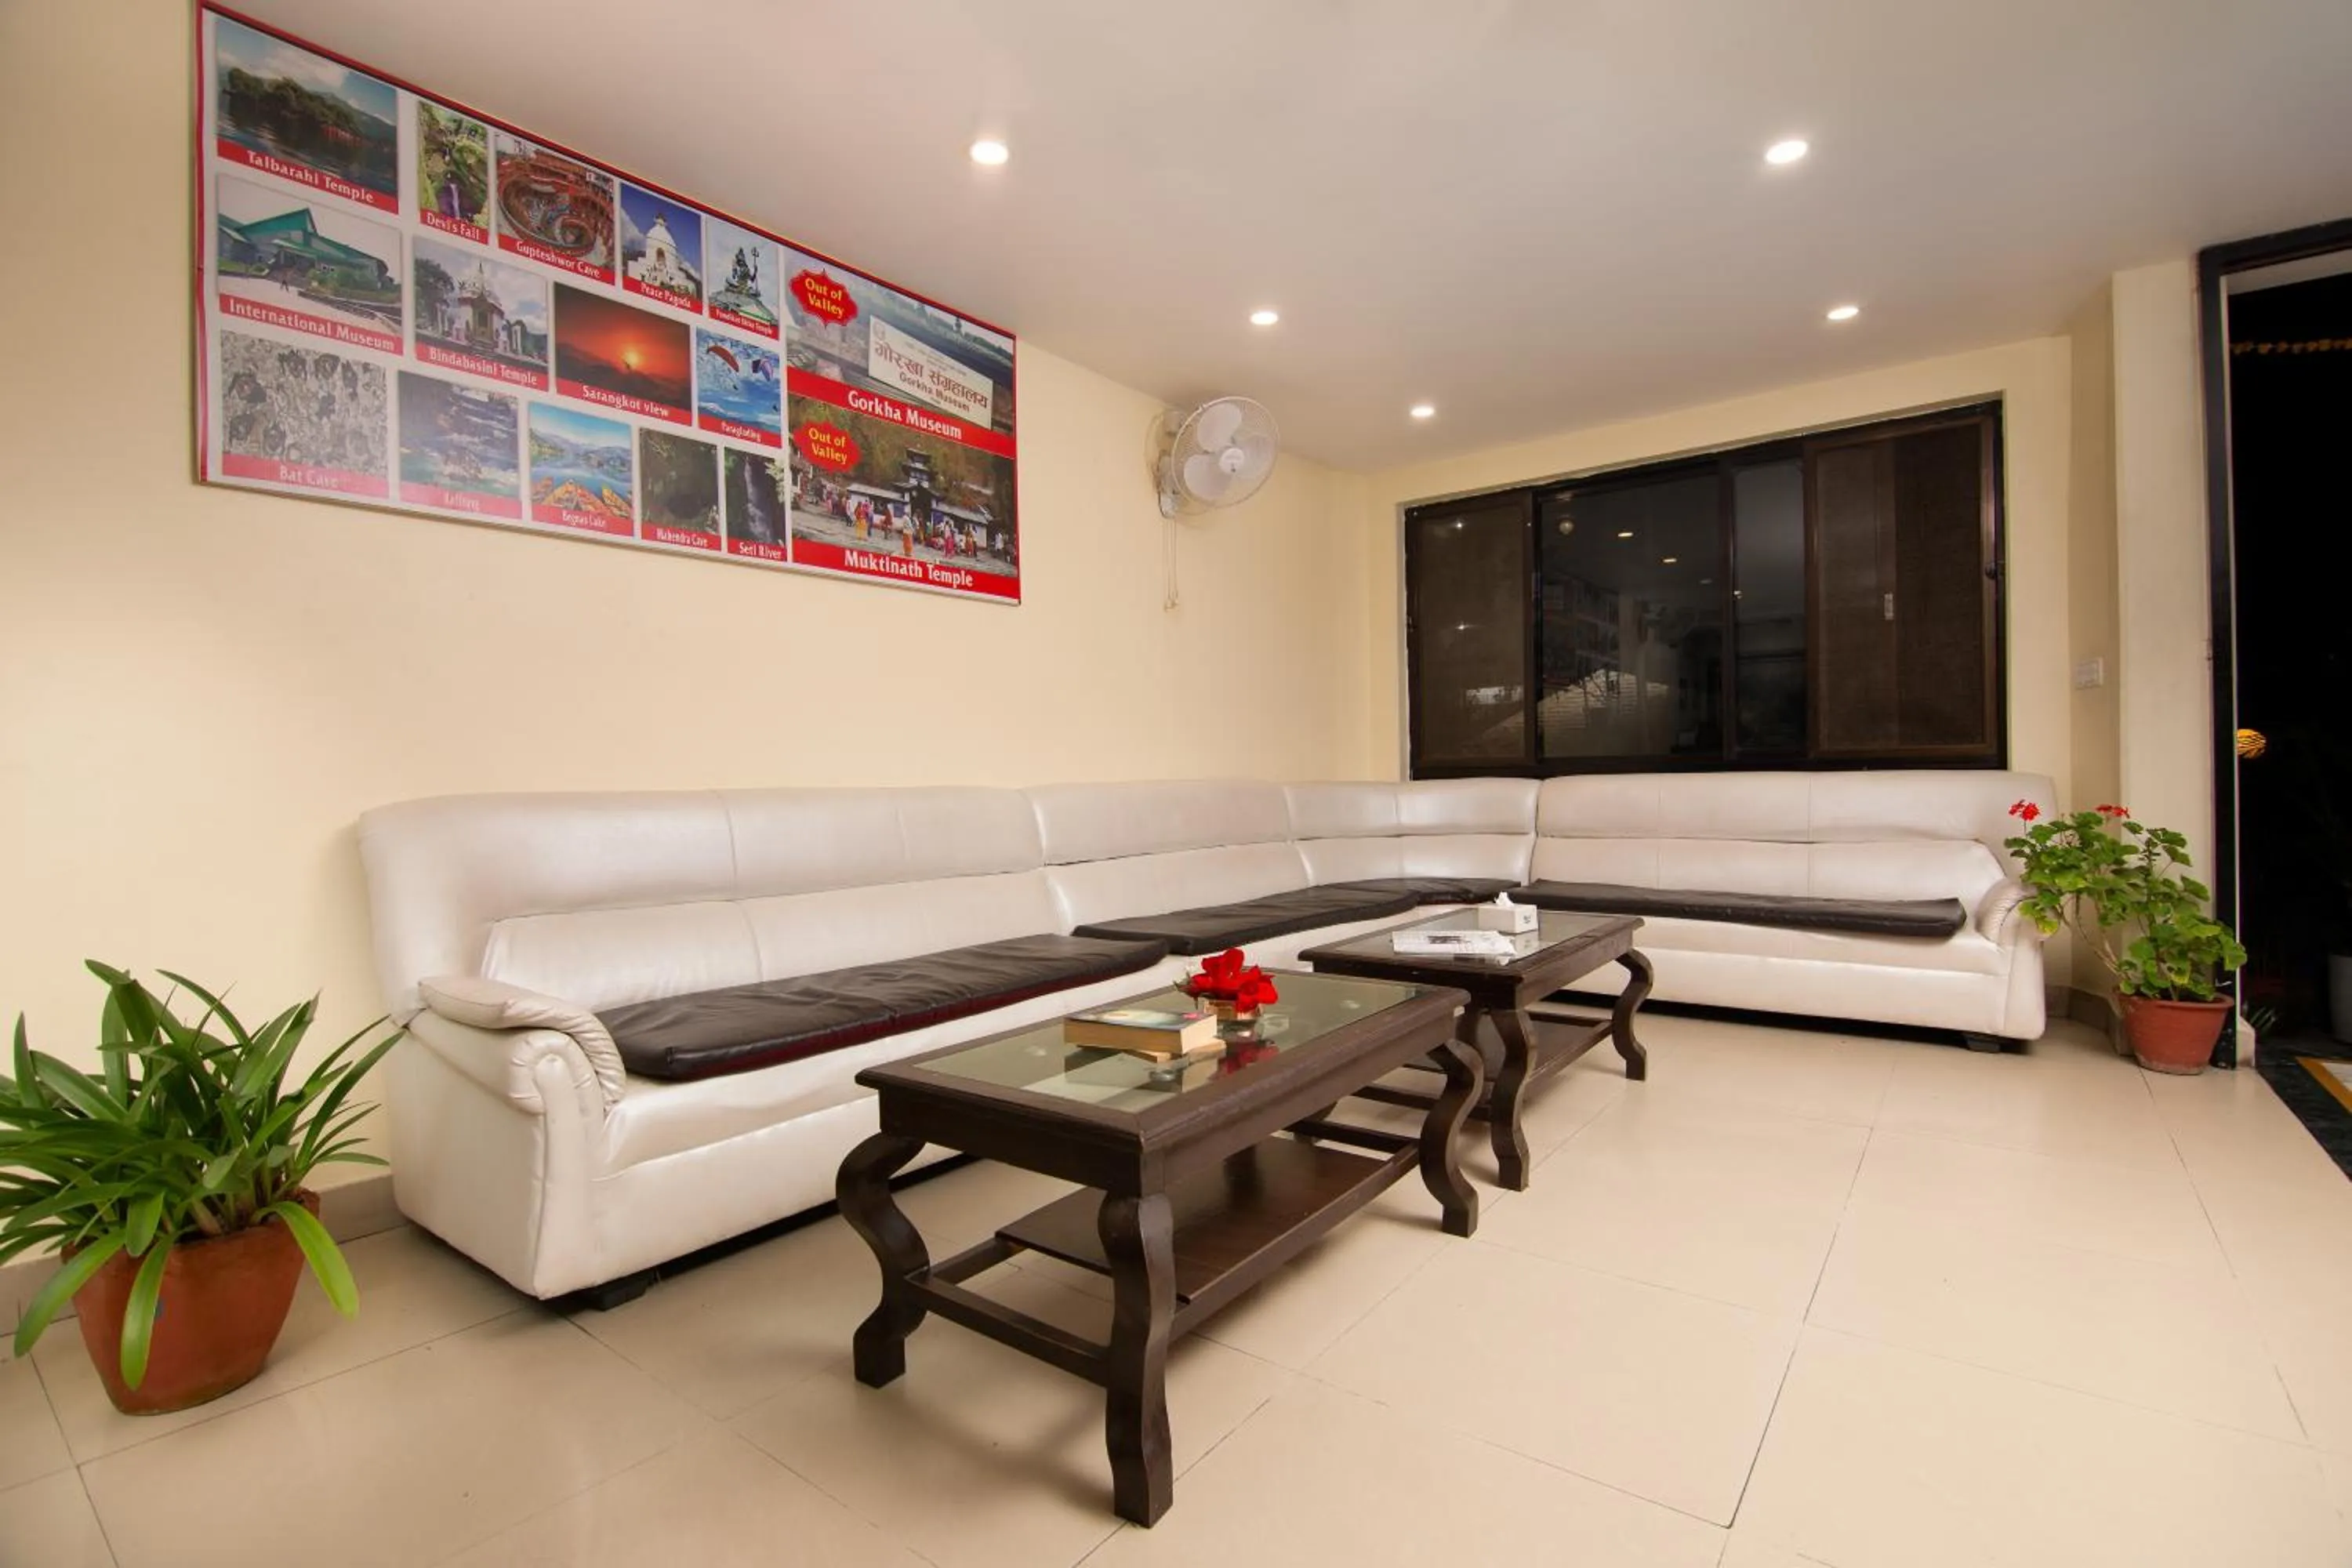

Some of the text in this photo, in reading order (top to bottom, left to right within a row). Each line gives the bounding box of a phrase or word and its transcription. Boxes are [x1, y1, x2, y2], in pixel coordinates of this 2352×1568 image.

[247, 150, 374, 203] Talbarahi Temple
[459, 223, 480, 241] Fall
[577, 260, 601, 278] Cave
[640, 281, 664, 299] Peace
[804, 277, 843, 301] Out of
[808, 292, 844, 319] Valley
[228, 298, 395, 350] International Museum
[429, 347, 538, 386] Bindabasini Temple
[582, 385, 669, 417] Sarangkot view
[899, 371, 970, 412] Gorkha Museum
[848, 390, 962, 440] Gorkha Museum
[808, 426, 846, 448] Out of
[811, 441, 848, 465] Valley
[279, 465, 303, 484] Bat
[739, 542, 782, 560] Seti River
[844, 549, 974, 589] Muktinath Temple
